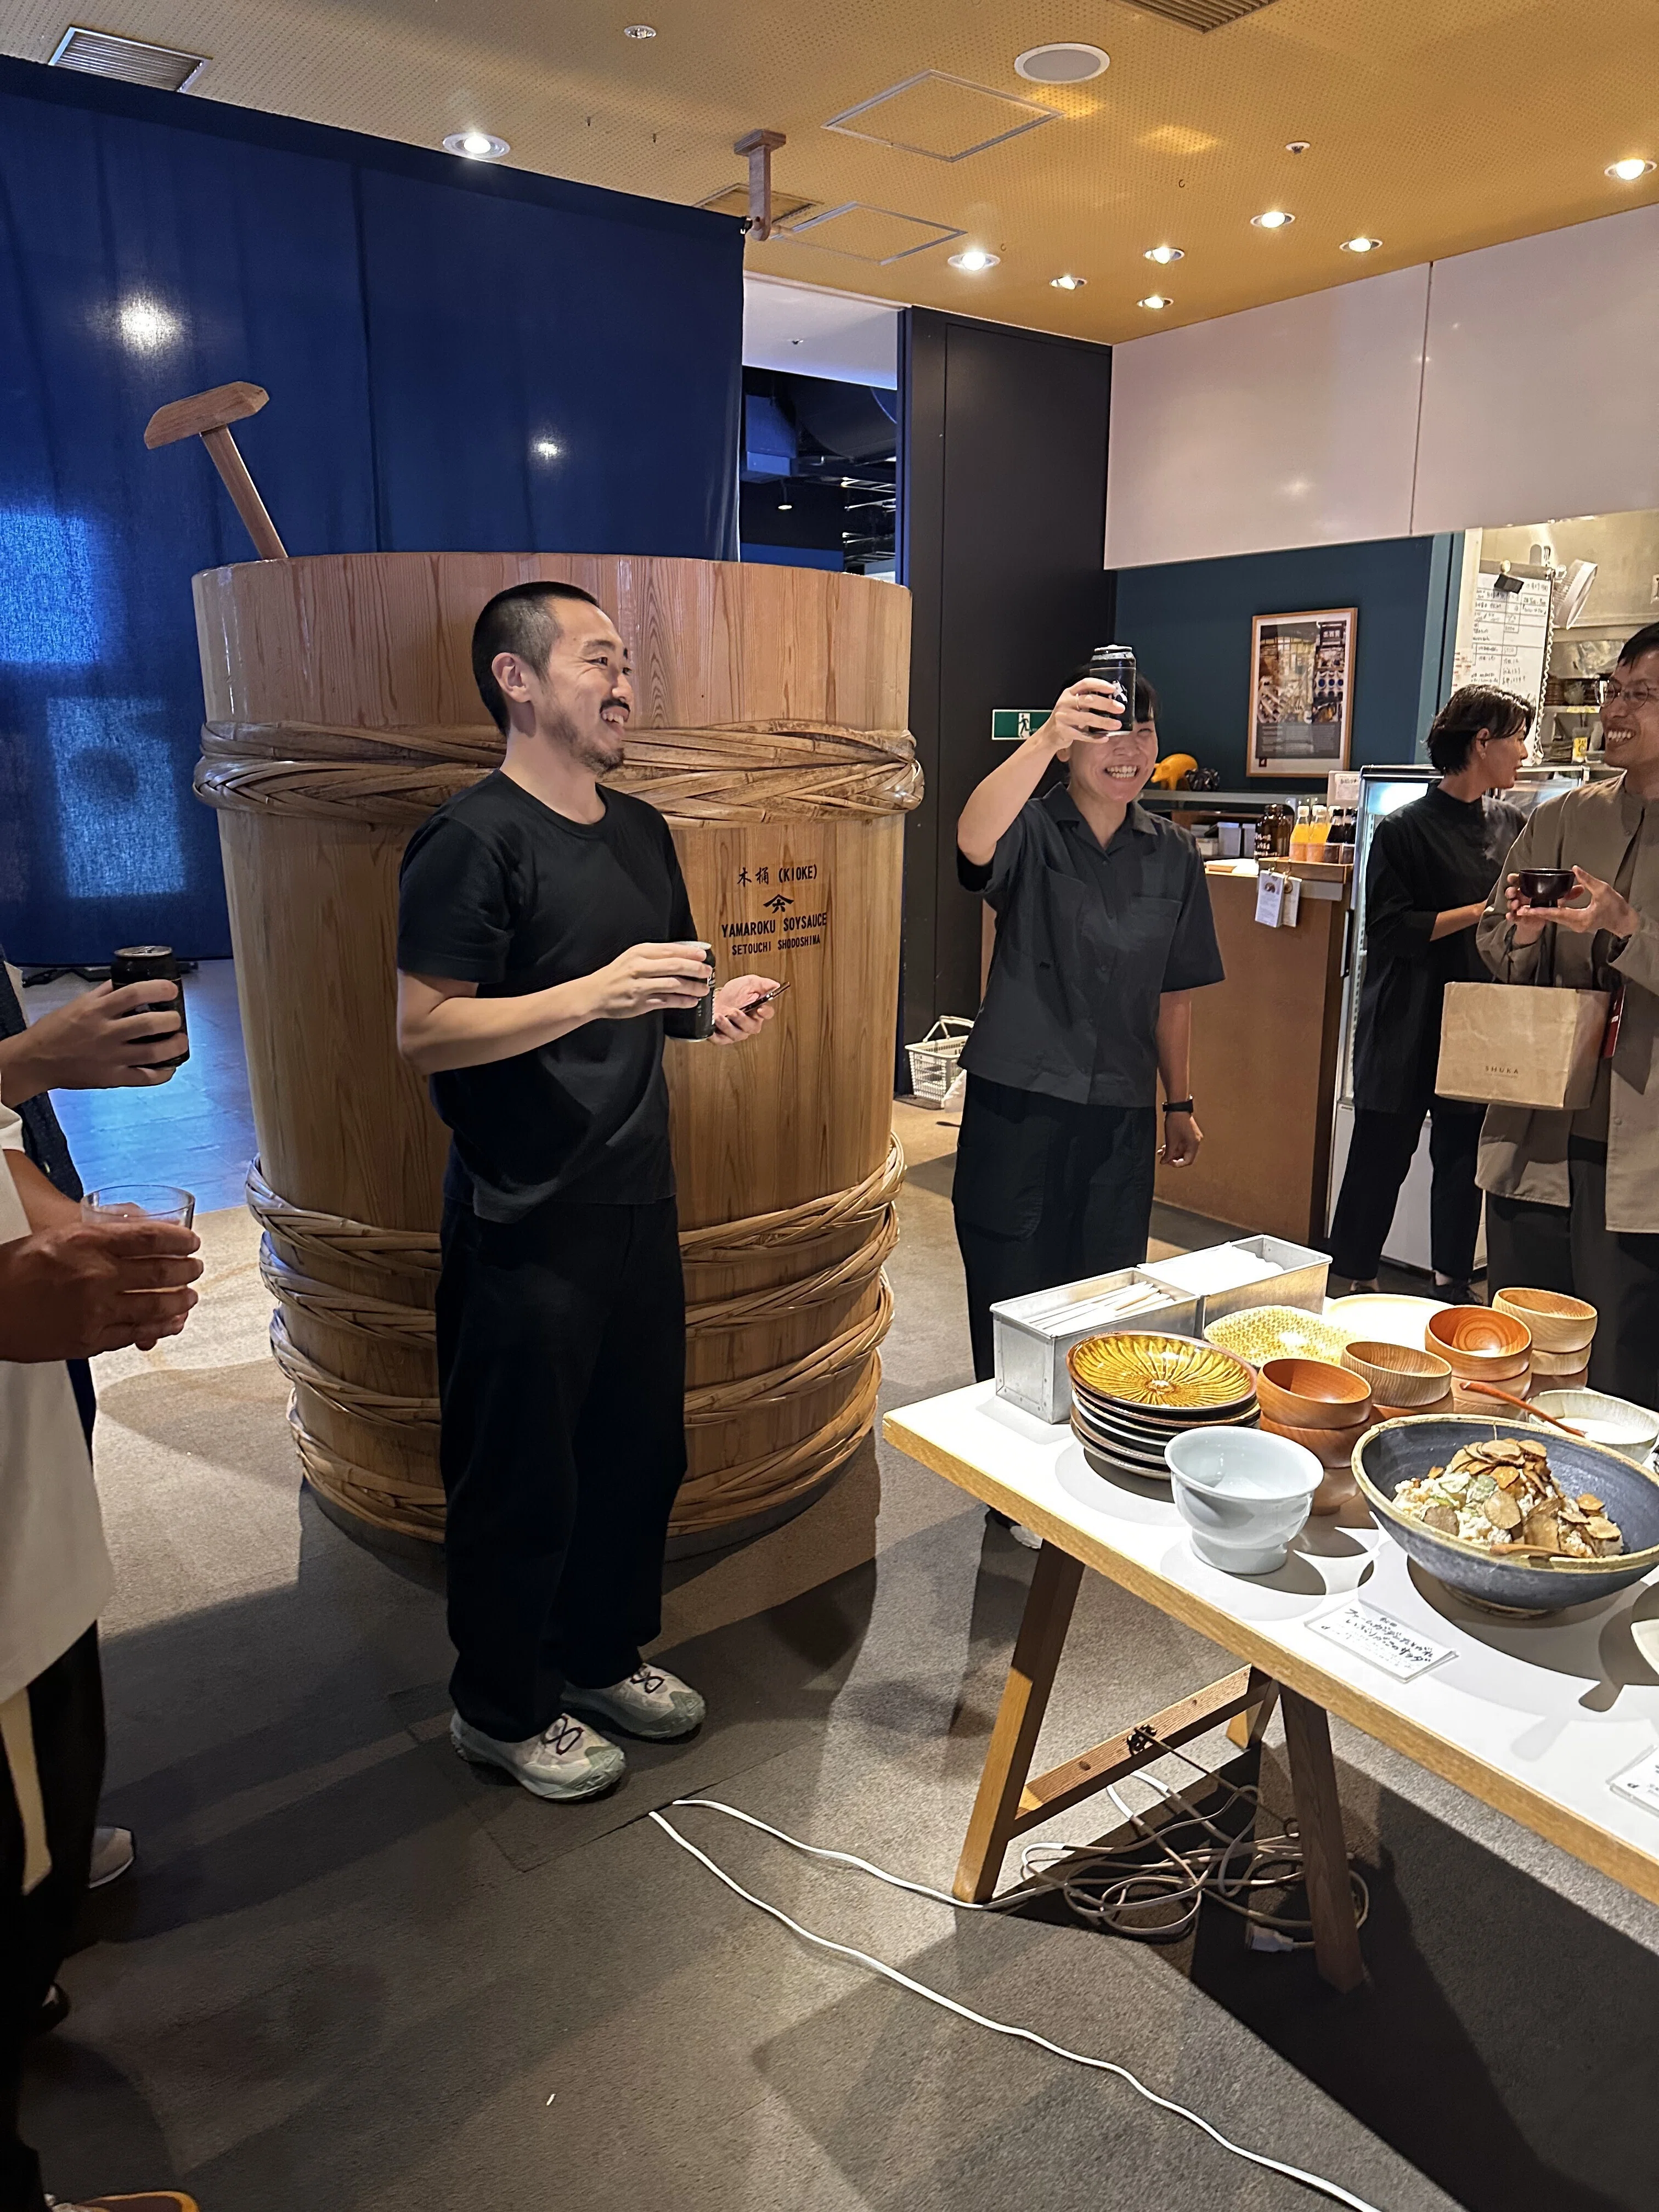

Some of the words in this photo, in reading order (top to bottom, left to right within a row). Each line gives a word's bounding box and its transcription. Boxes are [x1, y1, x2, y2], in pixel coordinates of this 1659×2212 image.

[737, 867, 769, 887] 木桶
[778, 864, 817, 883] (KIOKE)
[721, 919, 776, 938] YAMAROKU
[783, 912, 827, 932] SOYSAUCE
[732, 941, 771, 955] SETOUCHI
[778, 934, 820, 950] SHODOSHIMA
[1485, 1065, 1519, 1074] SHUKA
